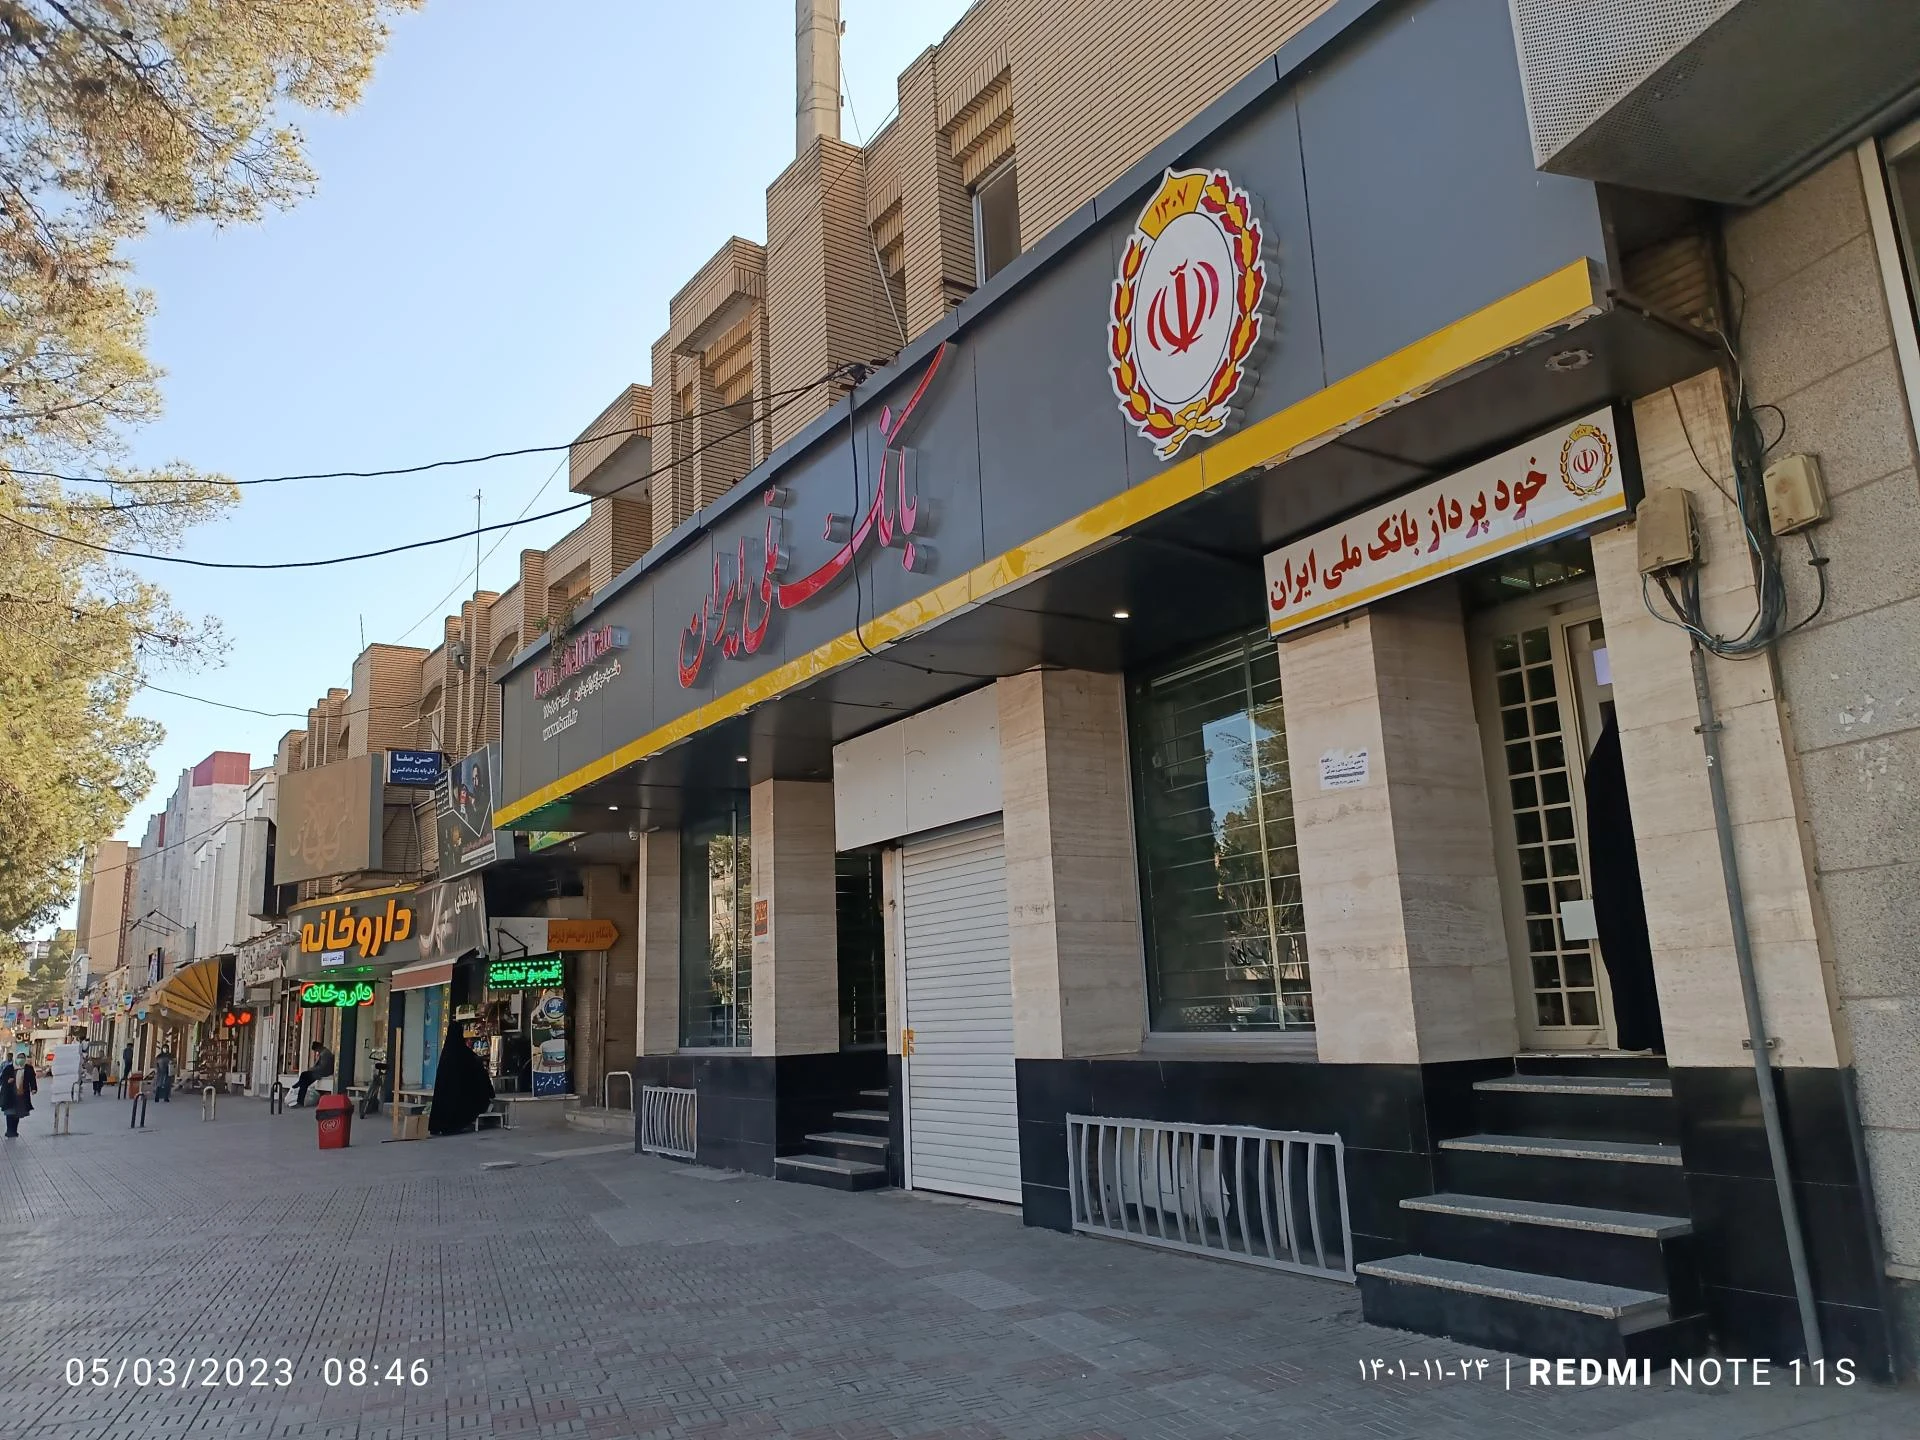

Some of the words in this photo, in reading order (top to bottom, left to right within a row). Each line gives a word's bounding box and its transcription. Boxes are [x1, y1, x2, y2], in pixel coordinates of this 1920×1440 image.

[1155, 182, 1190, 225] ۱۳۰۷
[778, 341, 946, 609] بانک
[1494, 457, 1547, 520] خود
[1368, 510, 1419, 556] بانک
[1428, 491, 1490, 553] پرداز
[1271, 548, 1317, 611] ایران
[1323, 534, 1362, 590] ملی
[678, 536, 745, 688] ایران
[396, 753, 413, 761] صفا
[415, 756, 433, 764] حسن
[301, 899, 411, 958] داروخانه
[303, 983, 373, 1006] داروخانه
